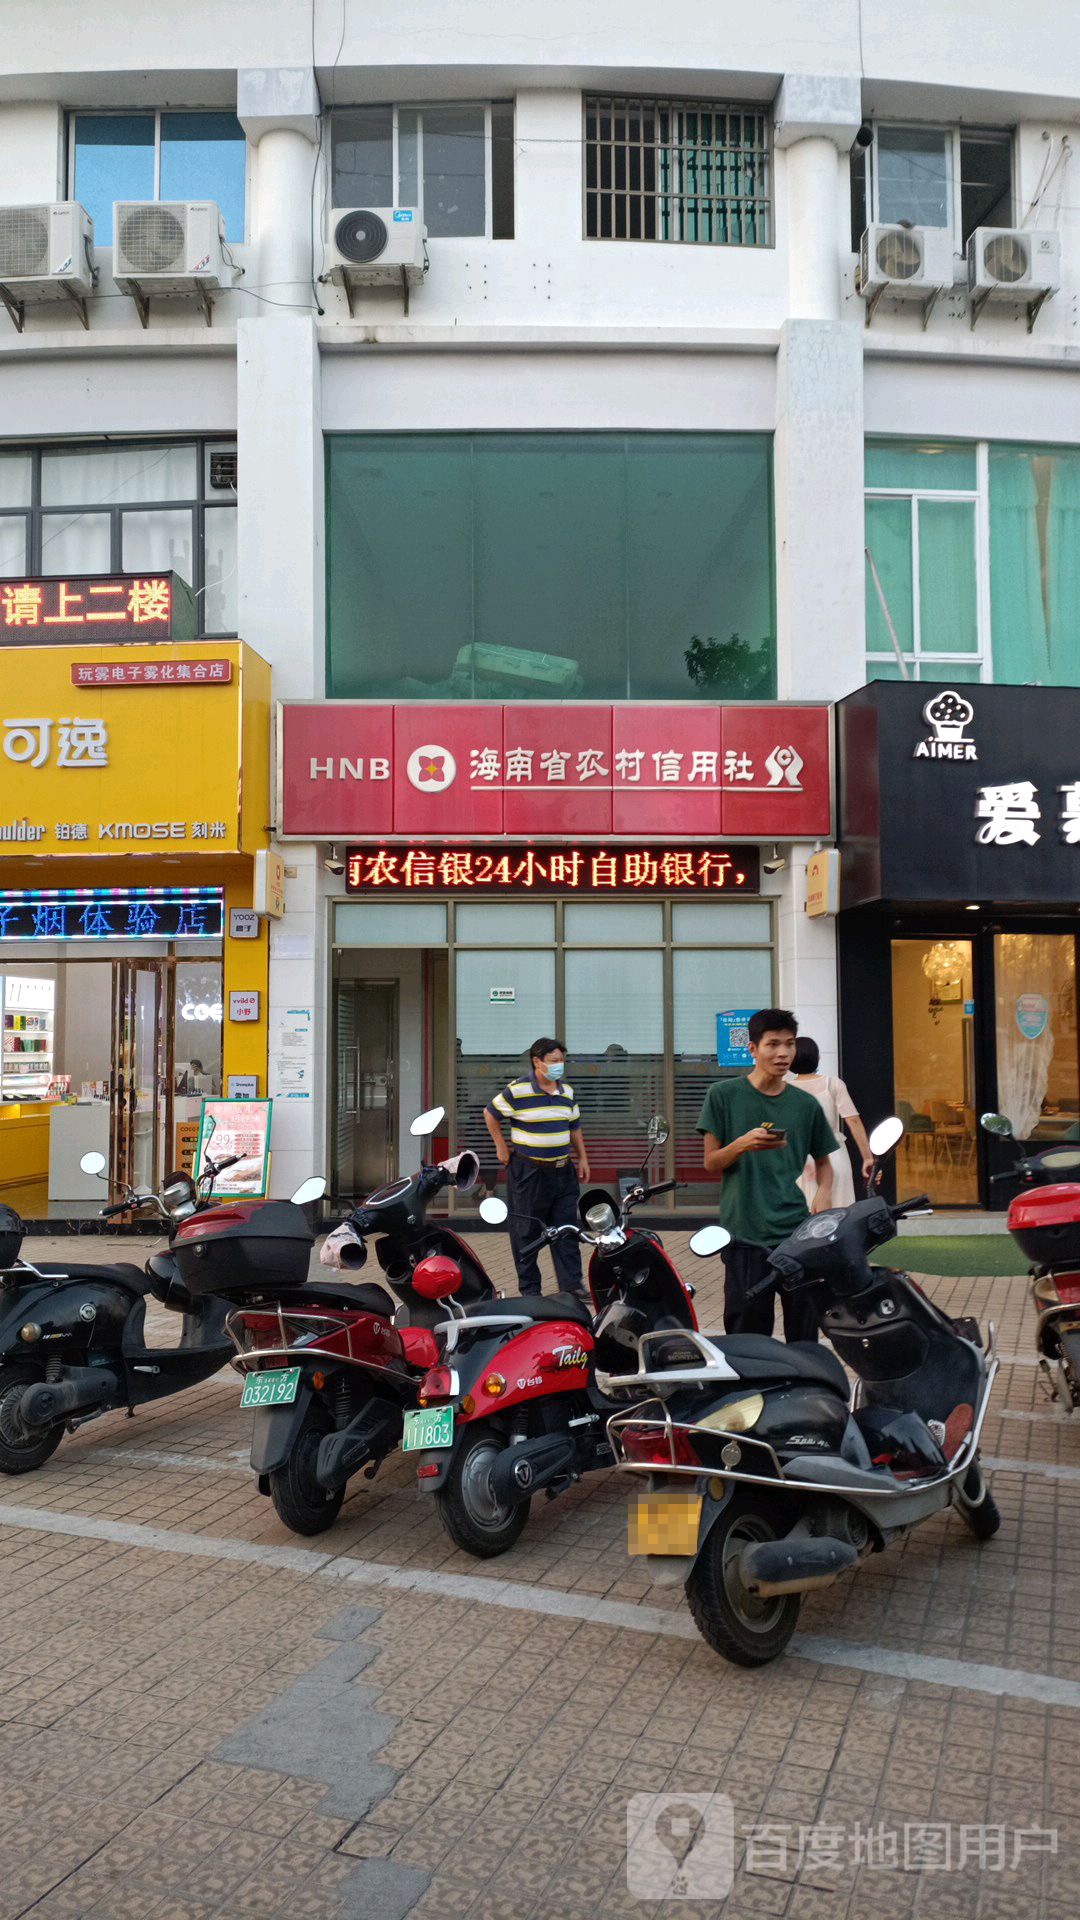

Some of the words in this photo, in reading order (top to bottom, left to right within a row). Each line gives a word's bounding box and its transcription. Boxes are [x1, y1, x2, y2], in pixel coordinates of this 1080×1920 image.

[1, 580, 169, 625] 请上二楼
[78, 663, 224, 681] 玩雾电子雾化集合店
[3, 718, 108, 768] 可逸
[310, 757, 390, 780] HNB
[469, 749, 755, 782] 海南省农村信用社
[0, 820, 46, 841] ulder
[55, 822, 88, 840] 铂德
[98, 821, 186, 840] KMOSE
[191, 821, 226, 840] 刻米
[552, 1345, 589, 1370] Tailg
[243, 1382, 295, 1405] 032192
[407, 1423, 450, 1448] 111803
